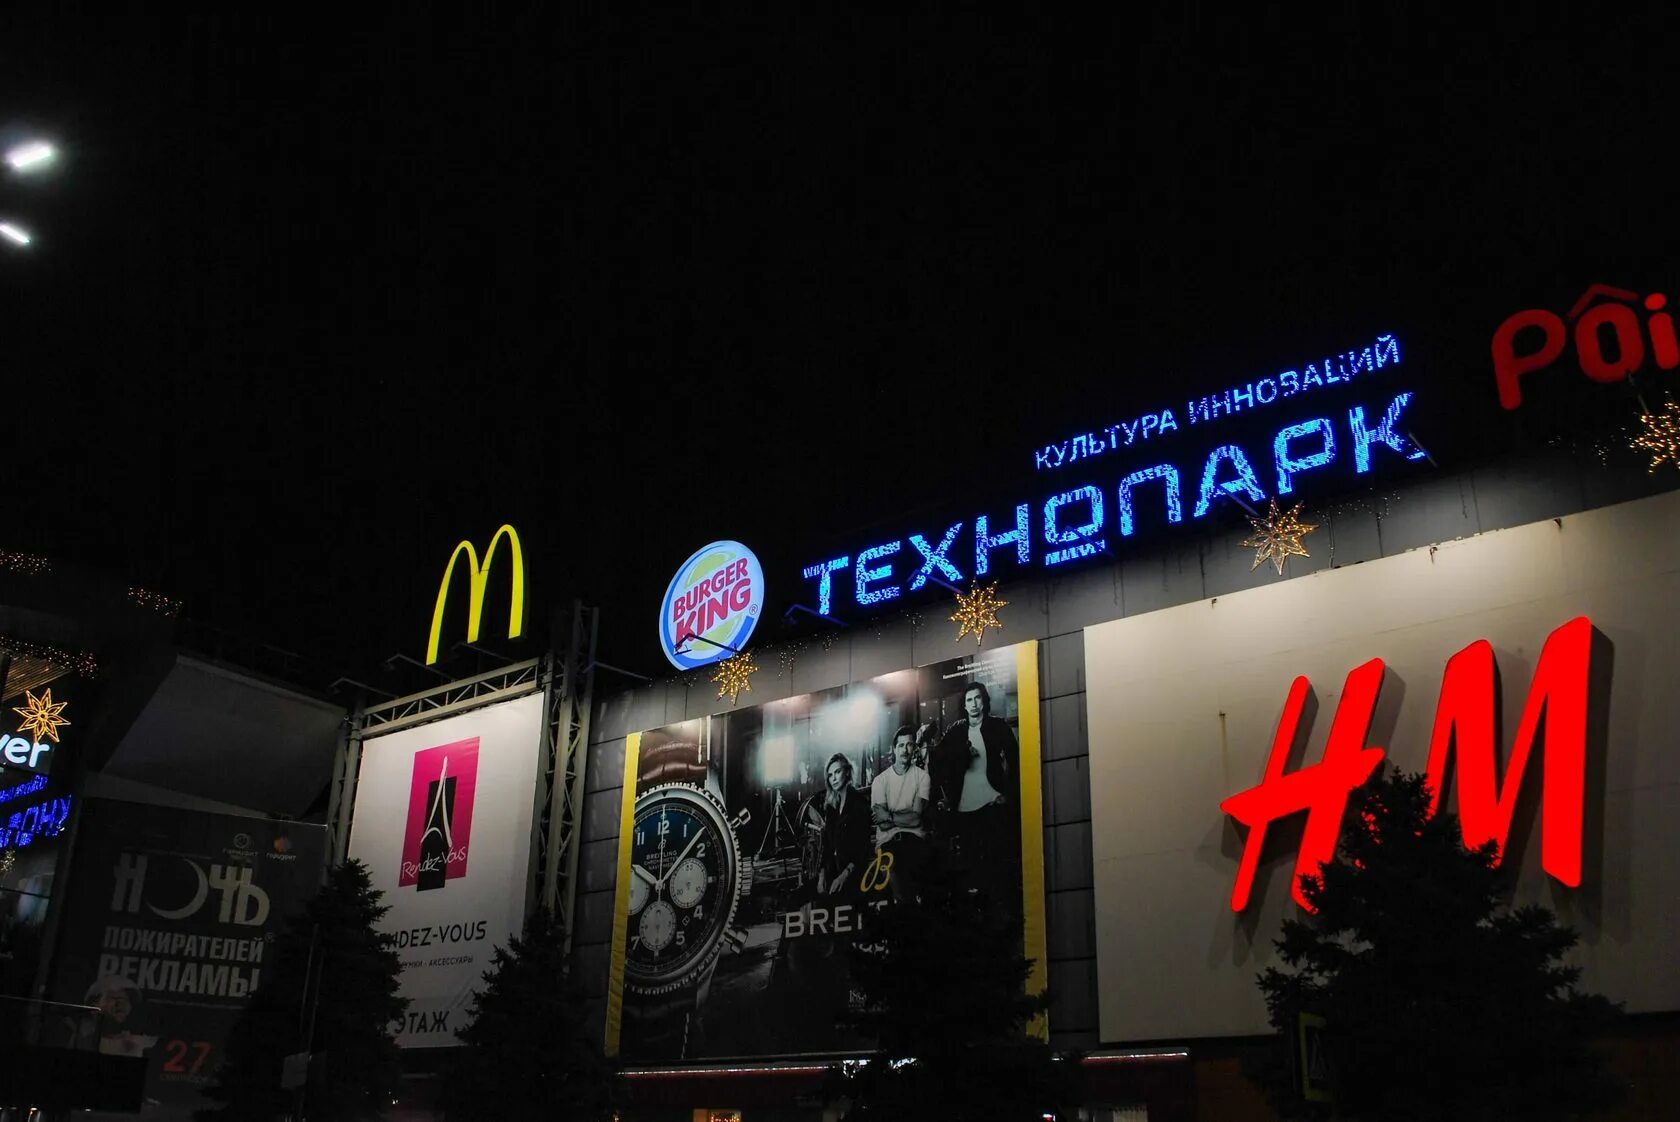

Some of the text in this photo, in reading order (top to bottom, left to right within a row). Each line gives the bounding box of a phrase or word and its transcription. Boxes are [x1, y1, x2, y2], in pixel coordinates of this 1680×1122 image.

[1034, 332, 1401, 471] КУЛЬТУРА ИННОВАЦИЙ
[803, 391, 1427, 616] ТЕХНОПАРК
[673, 557, 748, 622] BURGER
[675, 578, 751, 650] KING
[104, 925, 264, 963] ПОЖИРАТЕЛЕЙ
[675, 930, 686, 945] 5
[429, 956, 473, 967] АКСЕССУАРЫ
[395, 1011, 449, 1034] ЭТАЖ
[163, 1039, 213, 1073] 27
